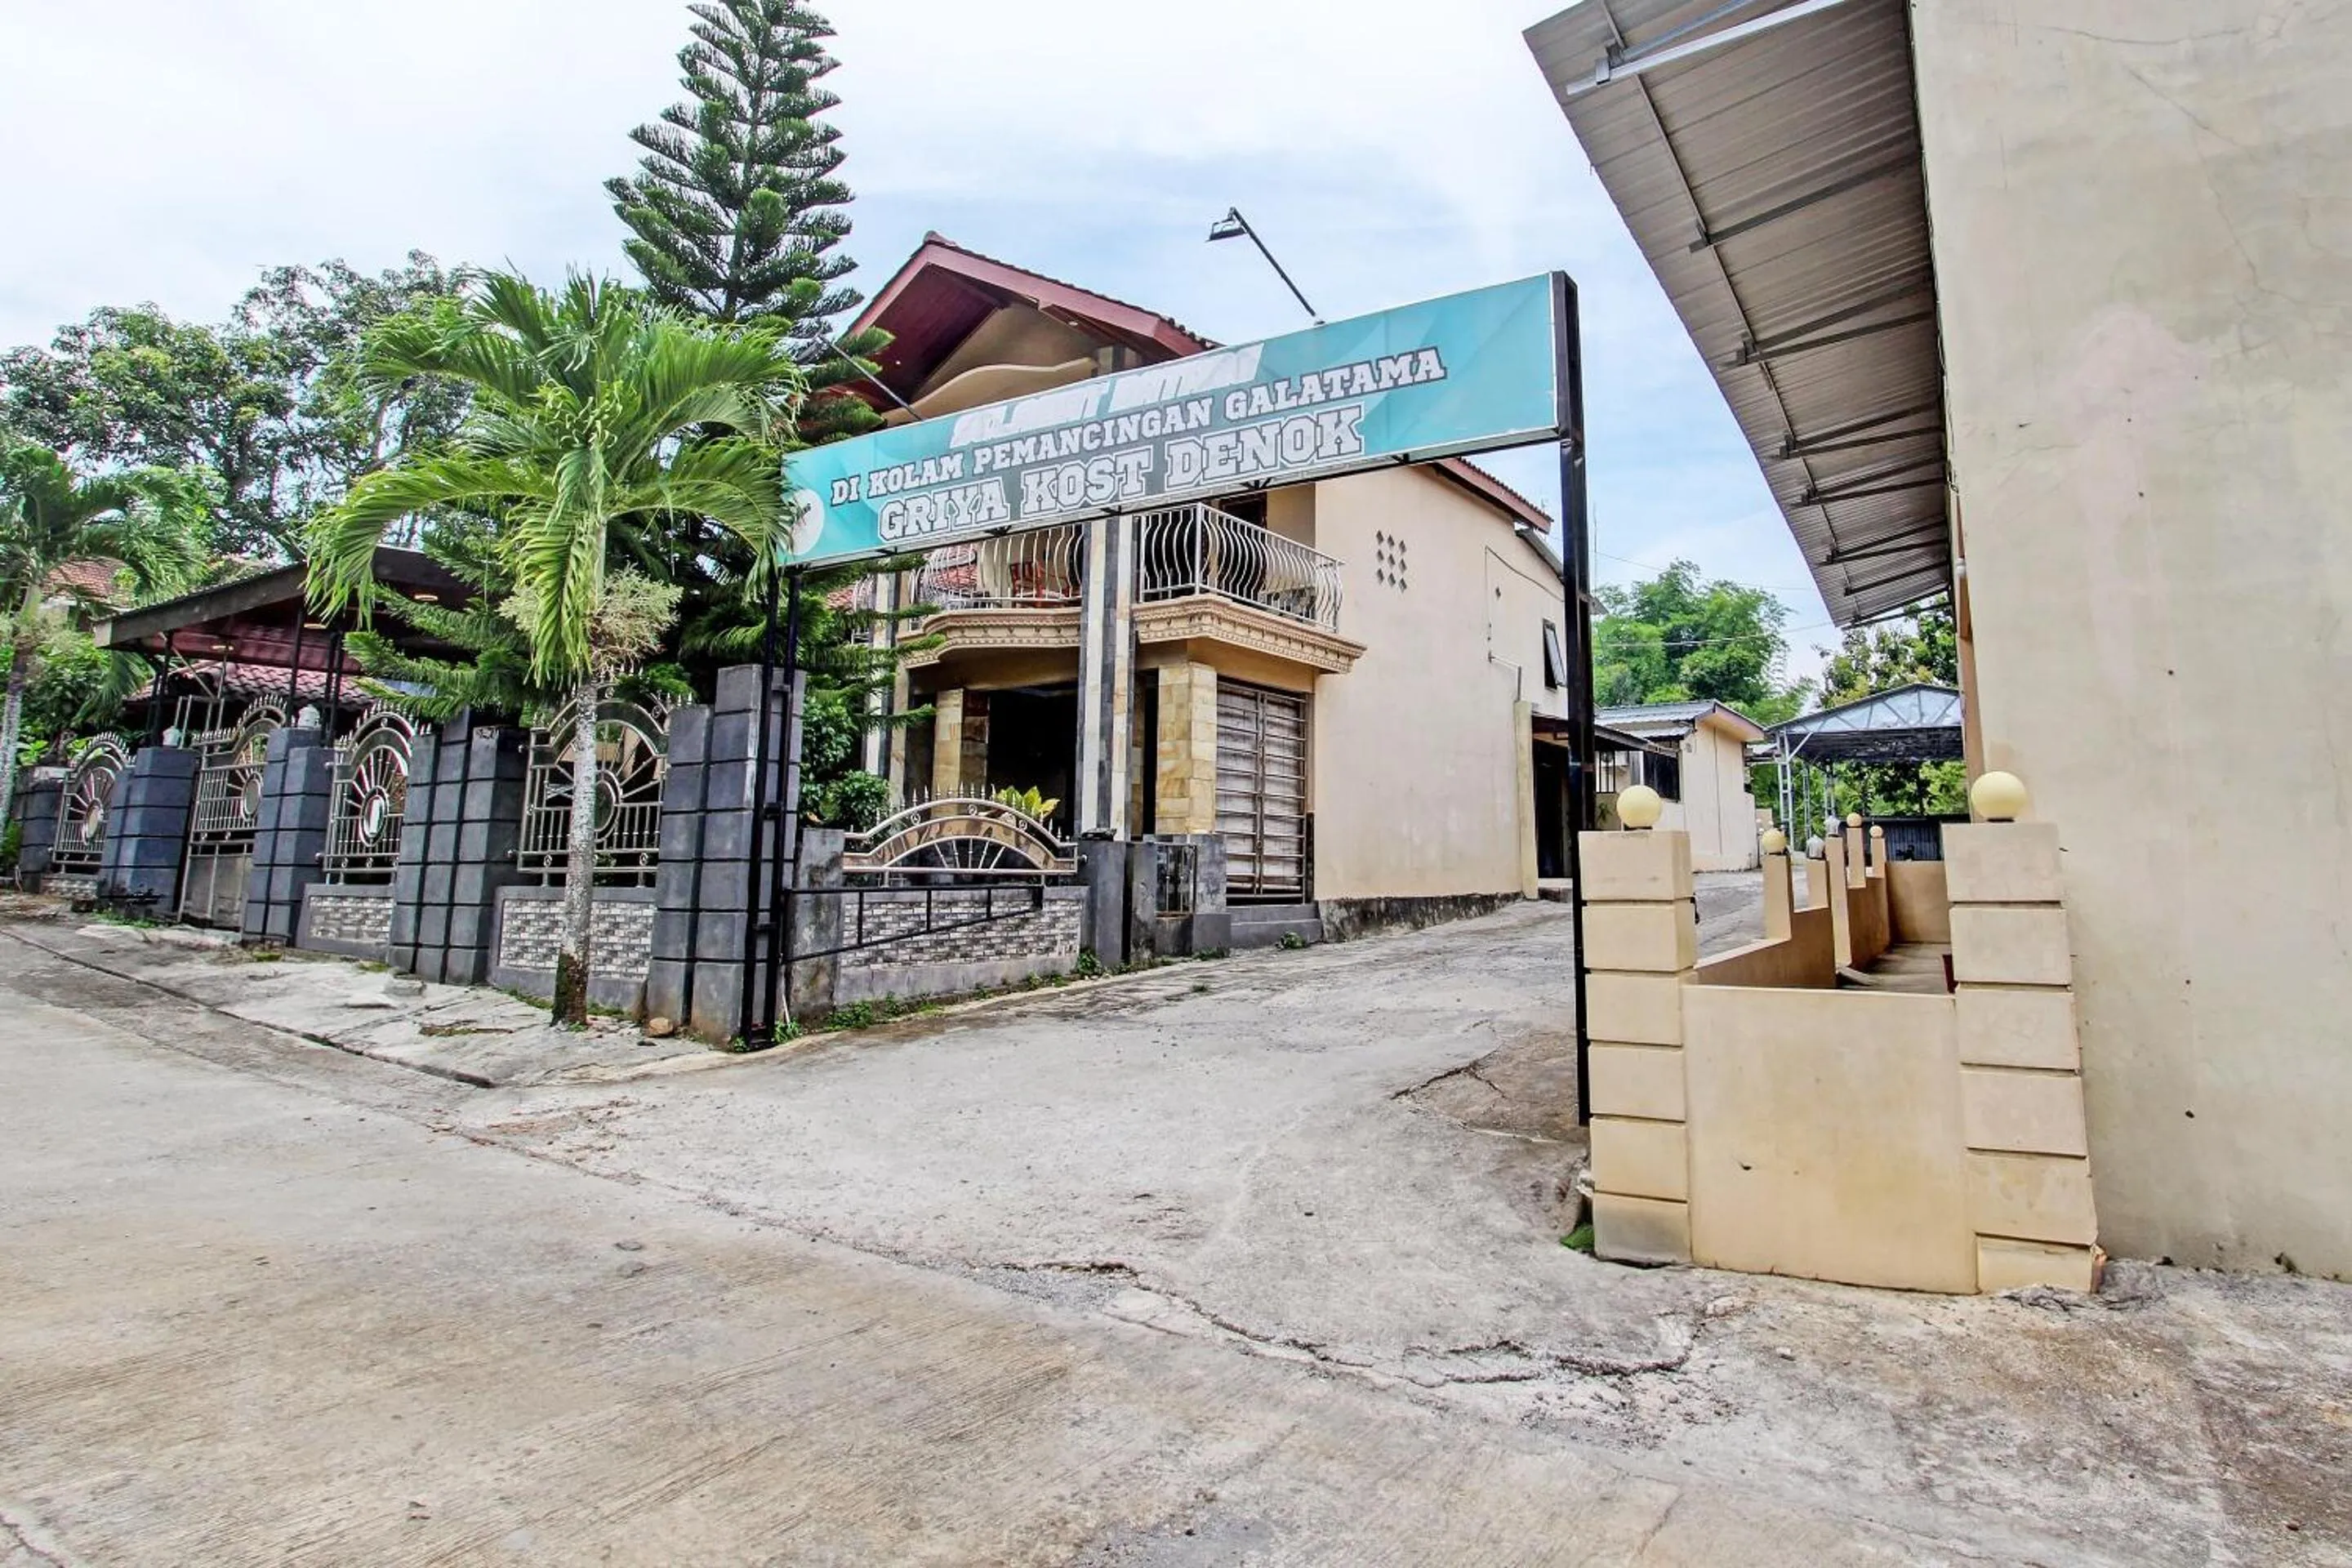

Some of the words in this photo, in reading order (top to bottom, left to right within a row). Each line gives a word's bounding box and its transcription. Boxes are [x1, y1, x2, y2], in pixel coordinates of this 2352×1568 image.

[831, 476, 861, 506] DI
[868, 453, 964, 496] KOLAM
[973, 396, 1214, 474] PEMANCINGAN
[1226, 347, 1446, 421] GALATAMA
[878, 479, 1011, 542] GRIYA
[1022, 447, 1153, 520] KOST
[1165, 403, 1365, 489] DENOK
